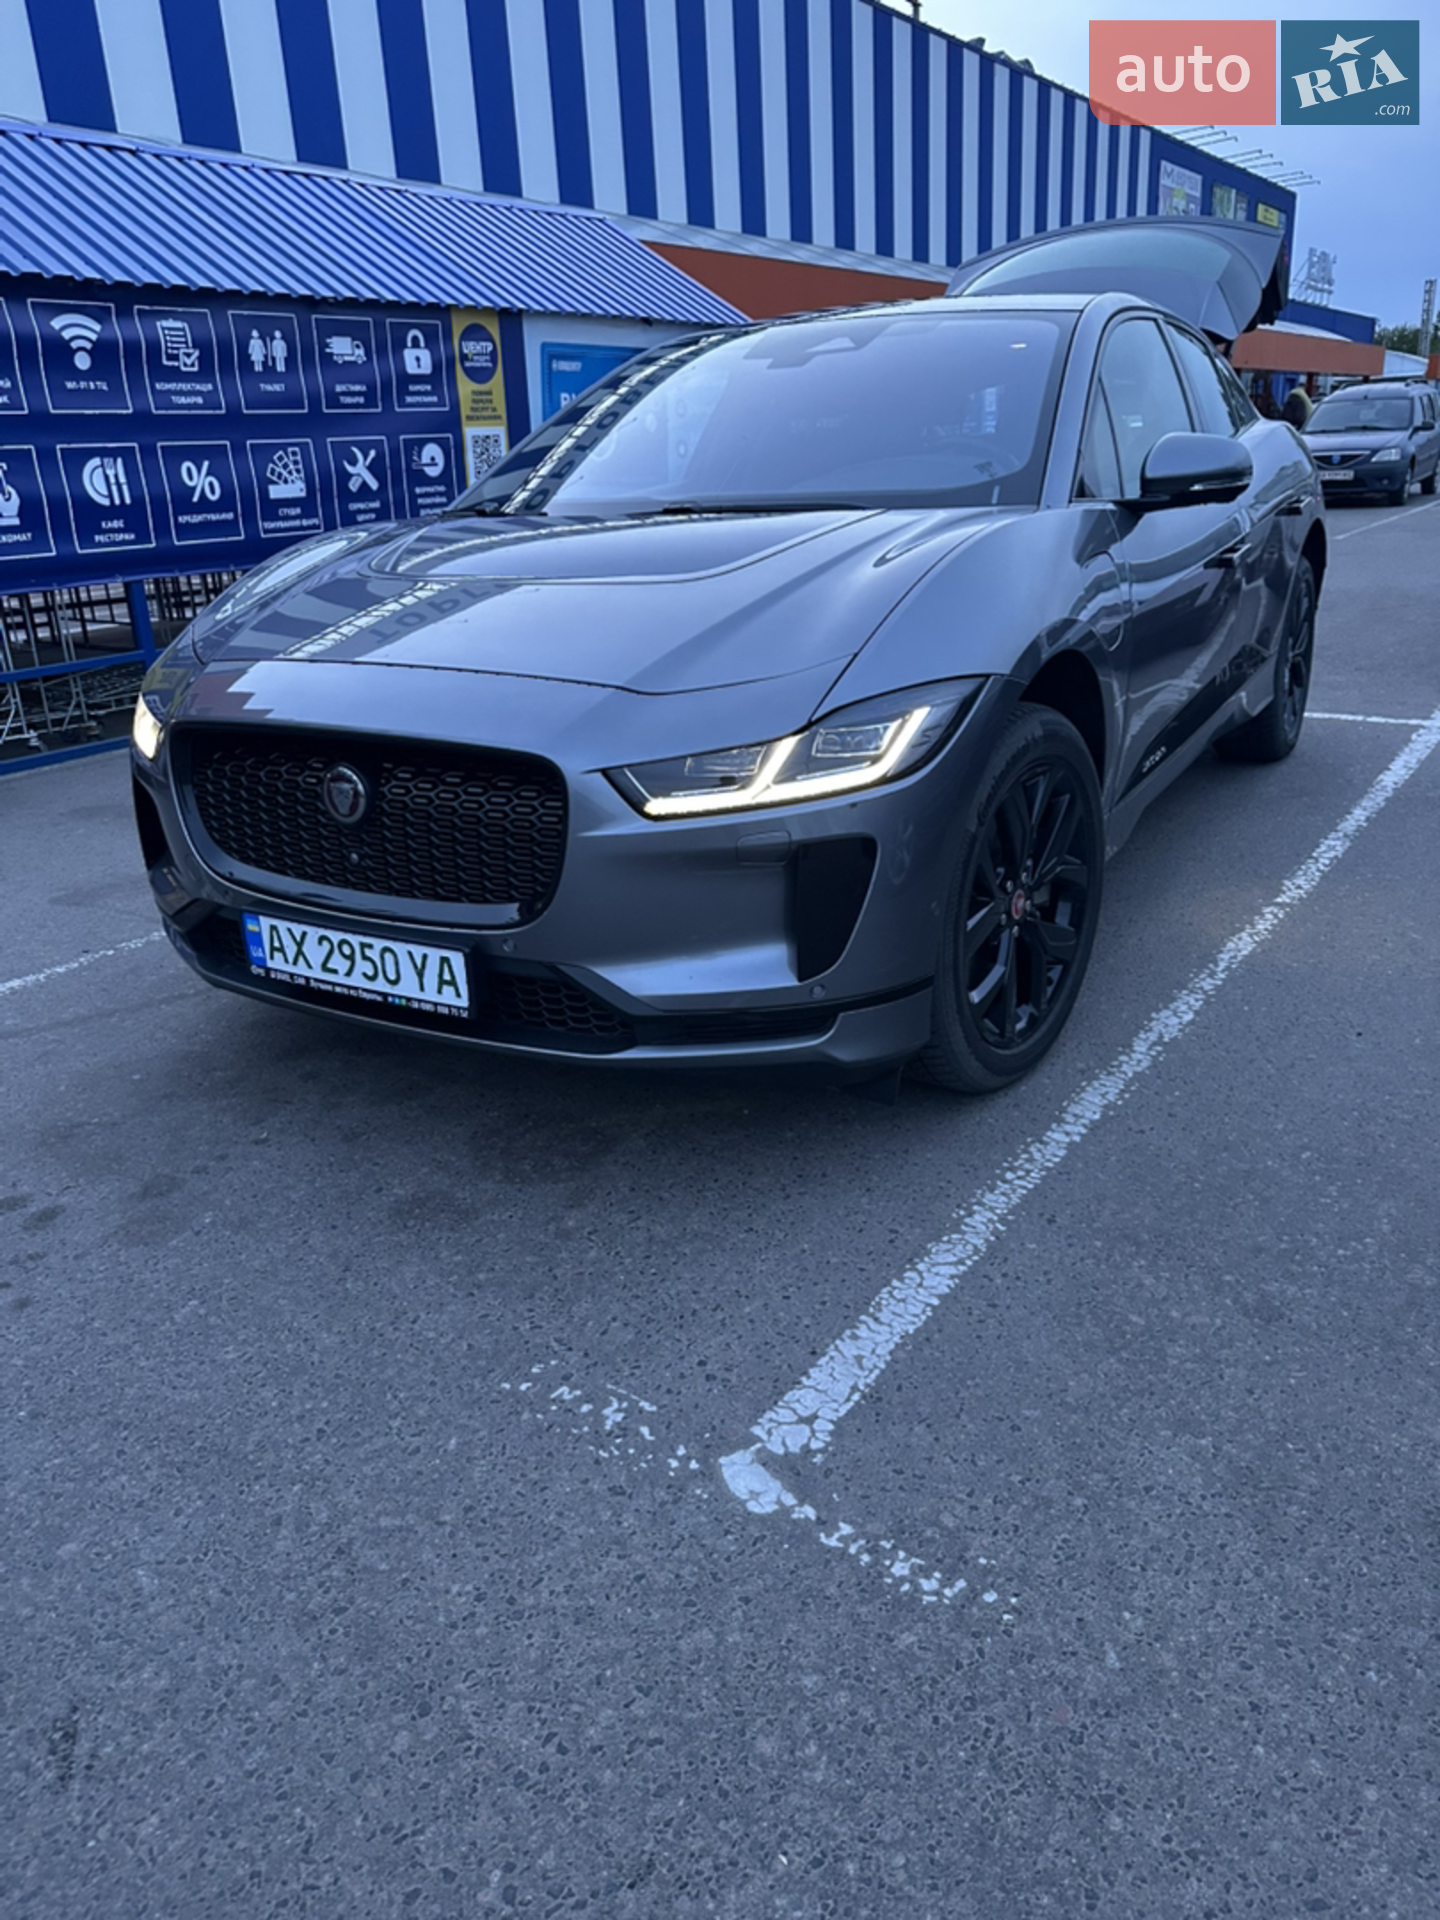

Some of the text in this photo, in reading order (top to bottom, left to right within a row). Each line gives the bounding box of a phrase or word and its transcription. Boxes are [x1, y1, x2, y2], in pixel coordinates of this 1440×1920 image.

[251, 944, 265, 957] UA
[268, 923, 463, 999] AX 2950 YA
